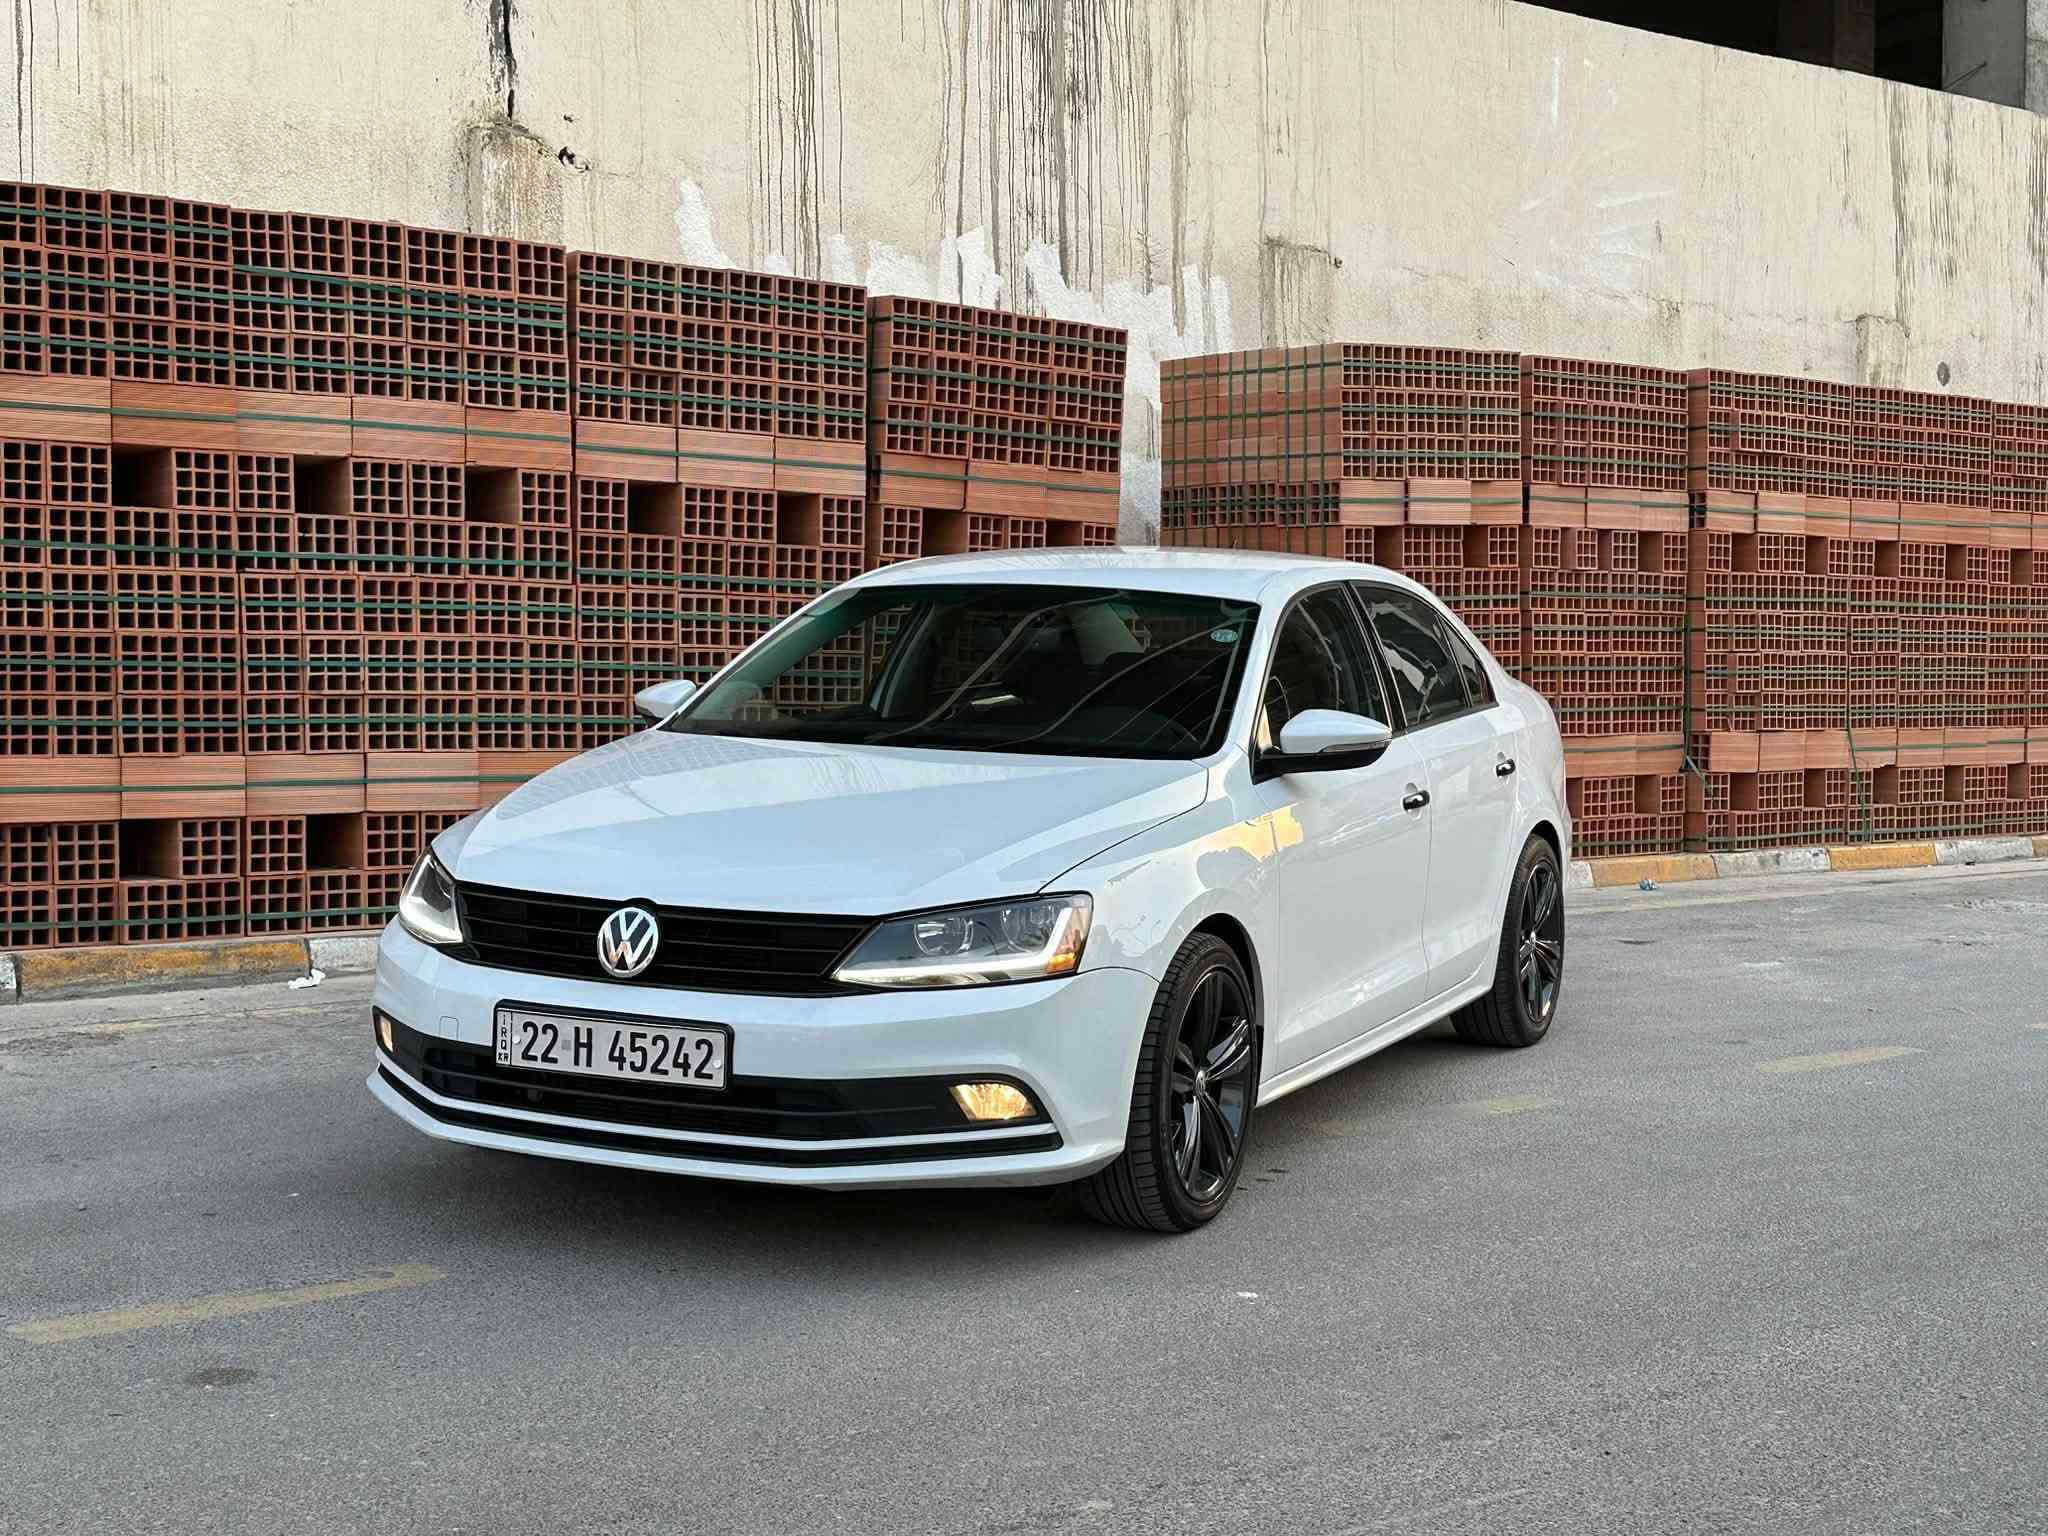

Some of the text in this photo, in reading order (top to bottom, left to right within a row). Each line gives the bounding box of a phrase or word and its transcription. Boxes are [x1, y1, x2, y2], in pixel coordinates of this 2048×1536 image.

[598, 907, 658, 977] VW
[521, 1021, 714, 1080] 22 H 45242
